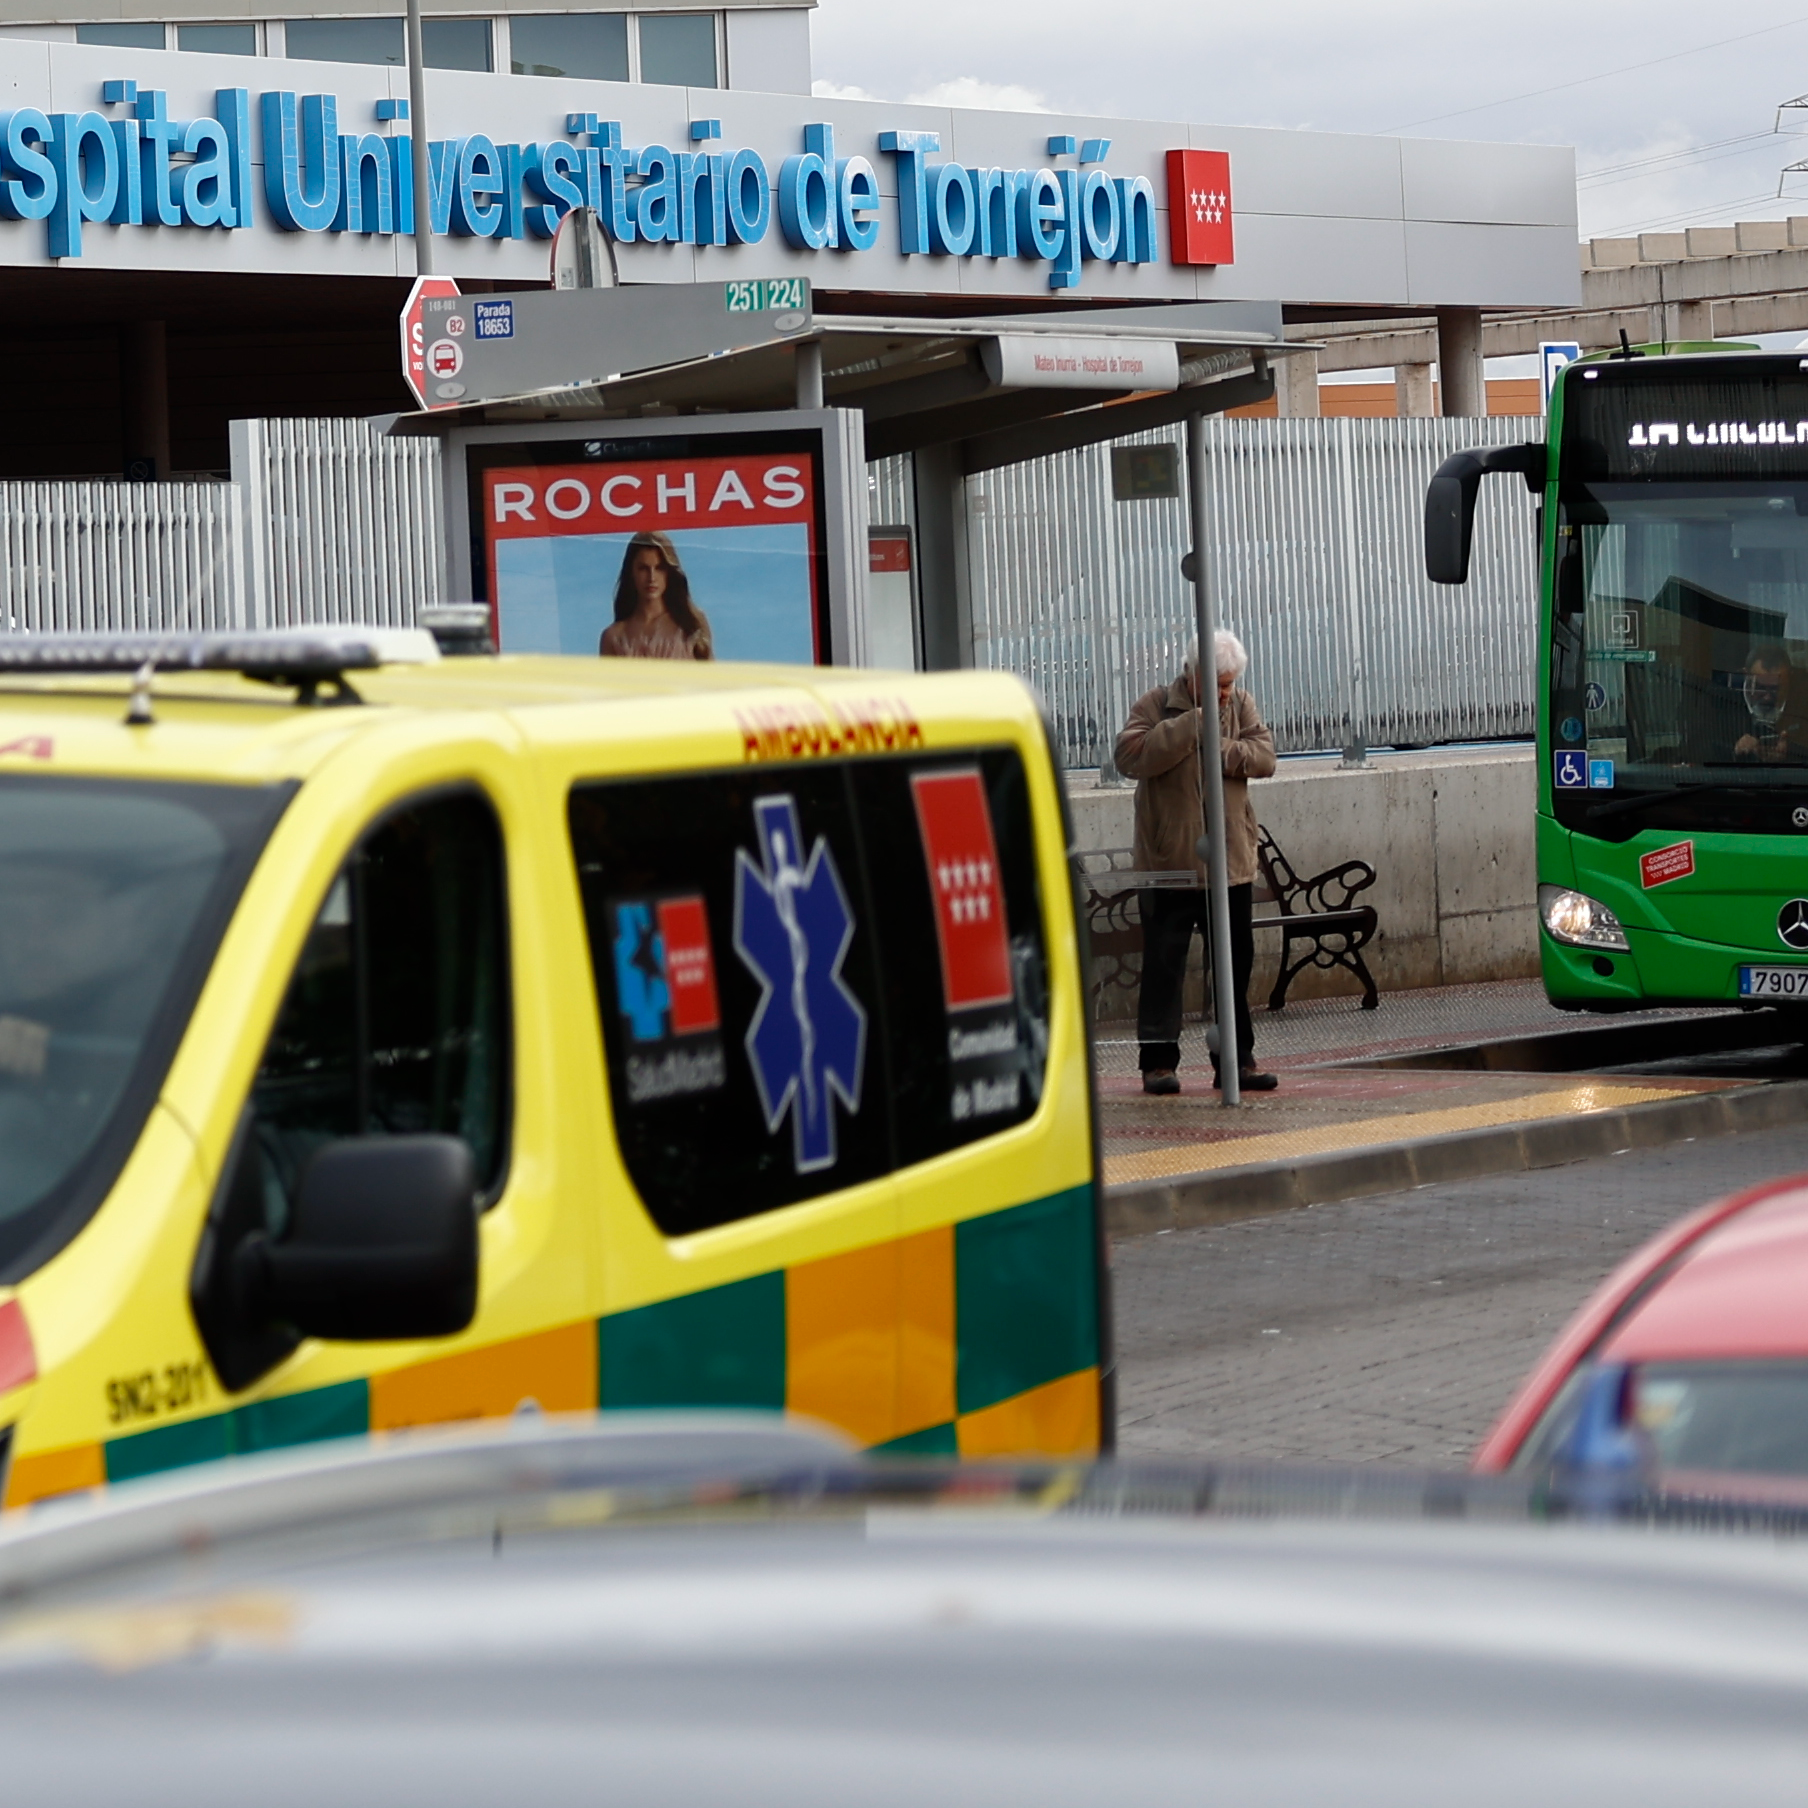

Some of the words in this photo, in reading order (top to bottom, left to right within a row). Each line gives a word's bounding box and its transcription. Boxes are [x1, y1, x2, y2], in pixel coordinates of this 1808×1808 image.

[261, 90, 772, 246] Universitario
[778, 122, 880, 252] de
[878, 130, 1159, 289] Torrejón
[728, 281, 759, 311] 251
[768, 278, 802, 309] 224
[477, 304, 511, 318] Parada
[449, 319, 463, 333] B2
[478, 318, 511, 336] 18653
[1034, 354, 1055, 372] Mateo
[1082, 355, 1108, 375] Hospital
[1109, 356, 1118, 373] de
[493, 465, 806, 524] ROCHAS
[733, 697, 926, 762] AMBULANCIA
[1755, 972, 1808, 995] 7907
